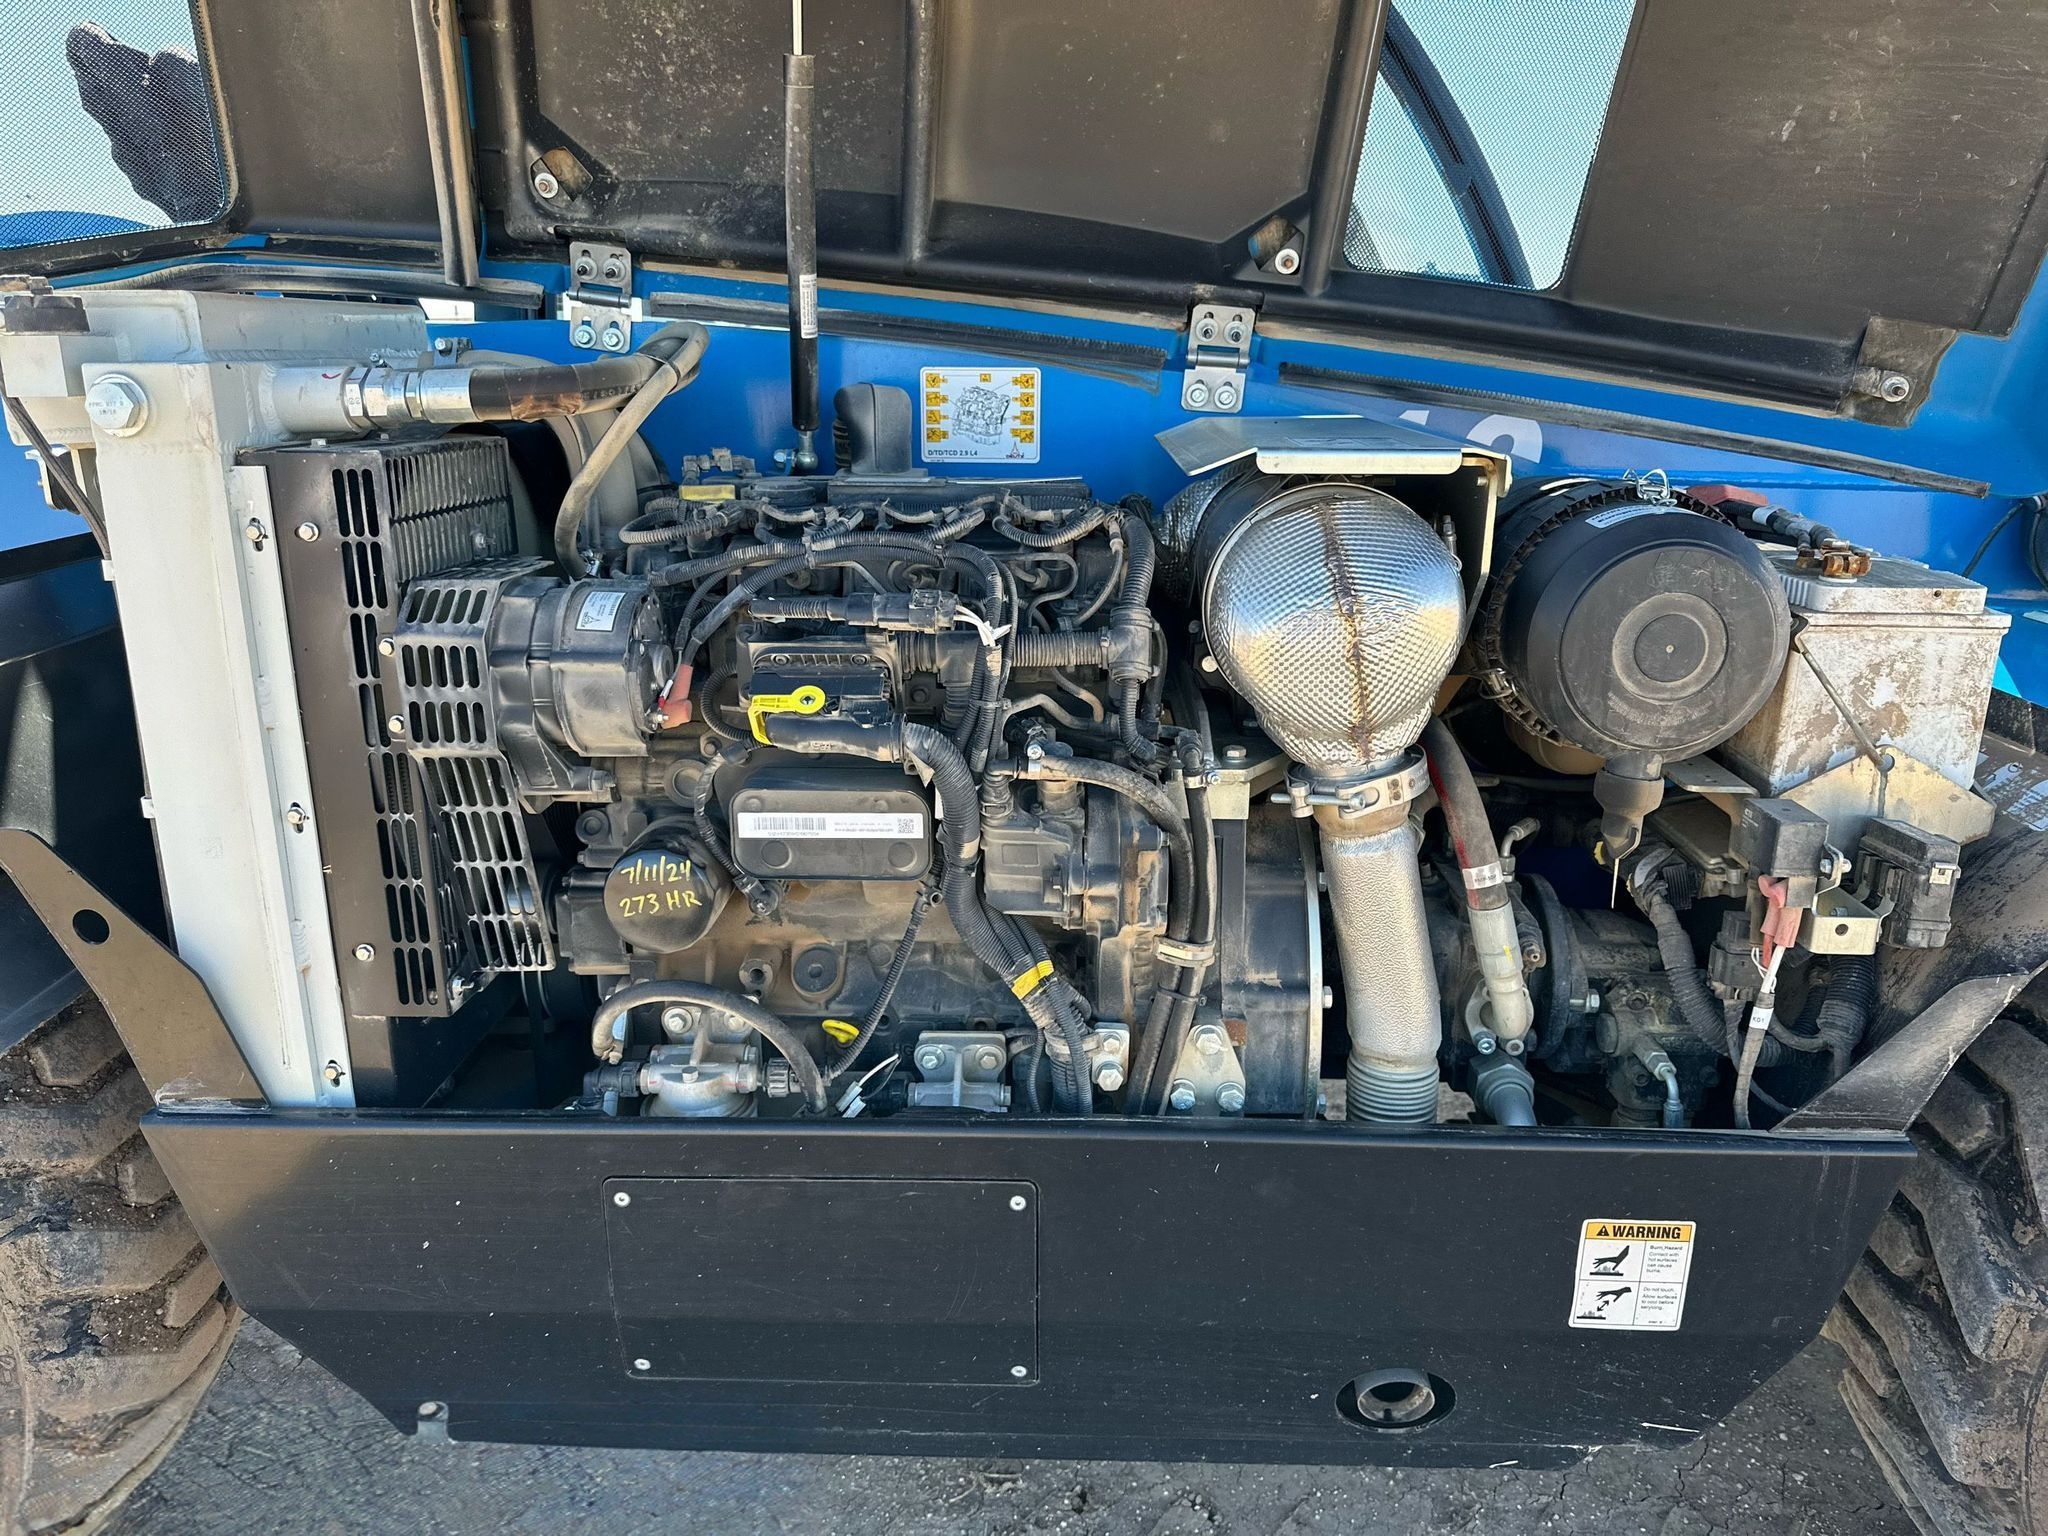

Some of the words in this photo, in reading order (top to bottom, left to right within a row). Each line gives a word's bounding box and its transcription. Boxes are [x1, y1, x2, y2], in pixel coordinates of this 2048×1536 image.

[620, 855, 691, 886] 7/11/24
[619, 893, 660, 918] 273
[665, 889, 702, 911] HR
[1612, 1225, 1682, 1239] WARNING
